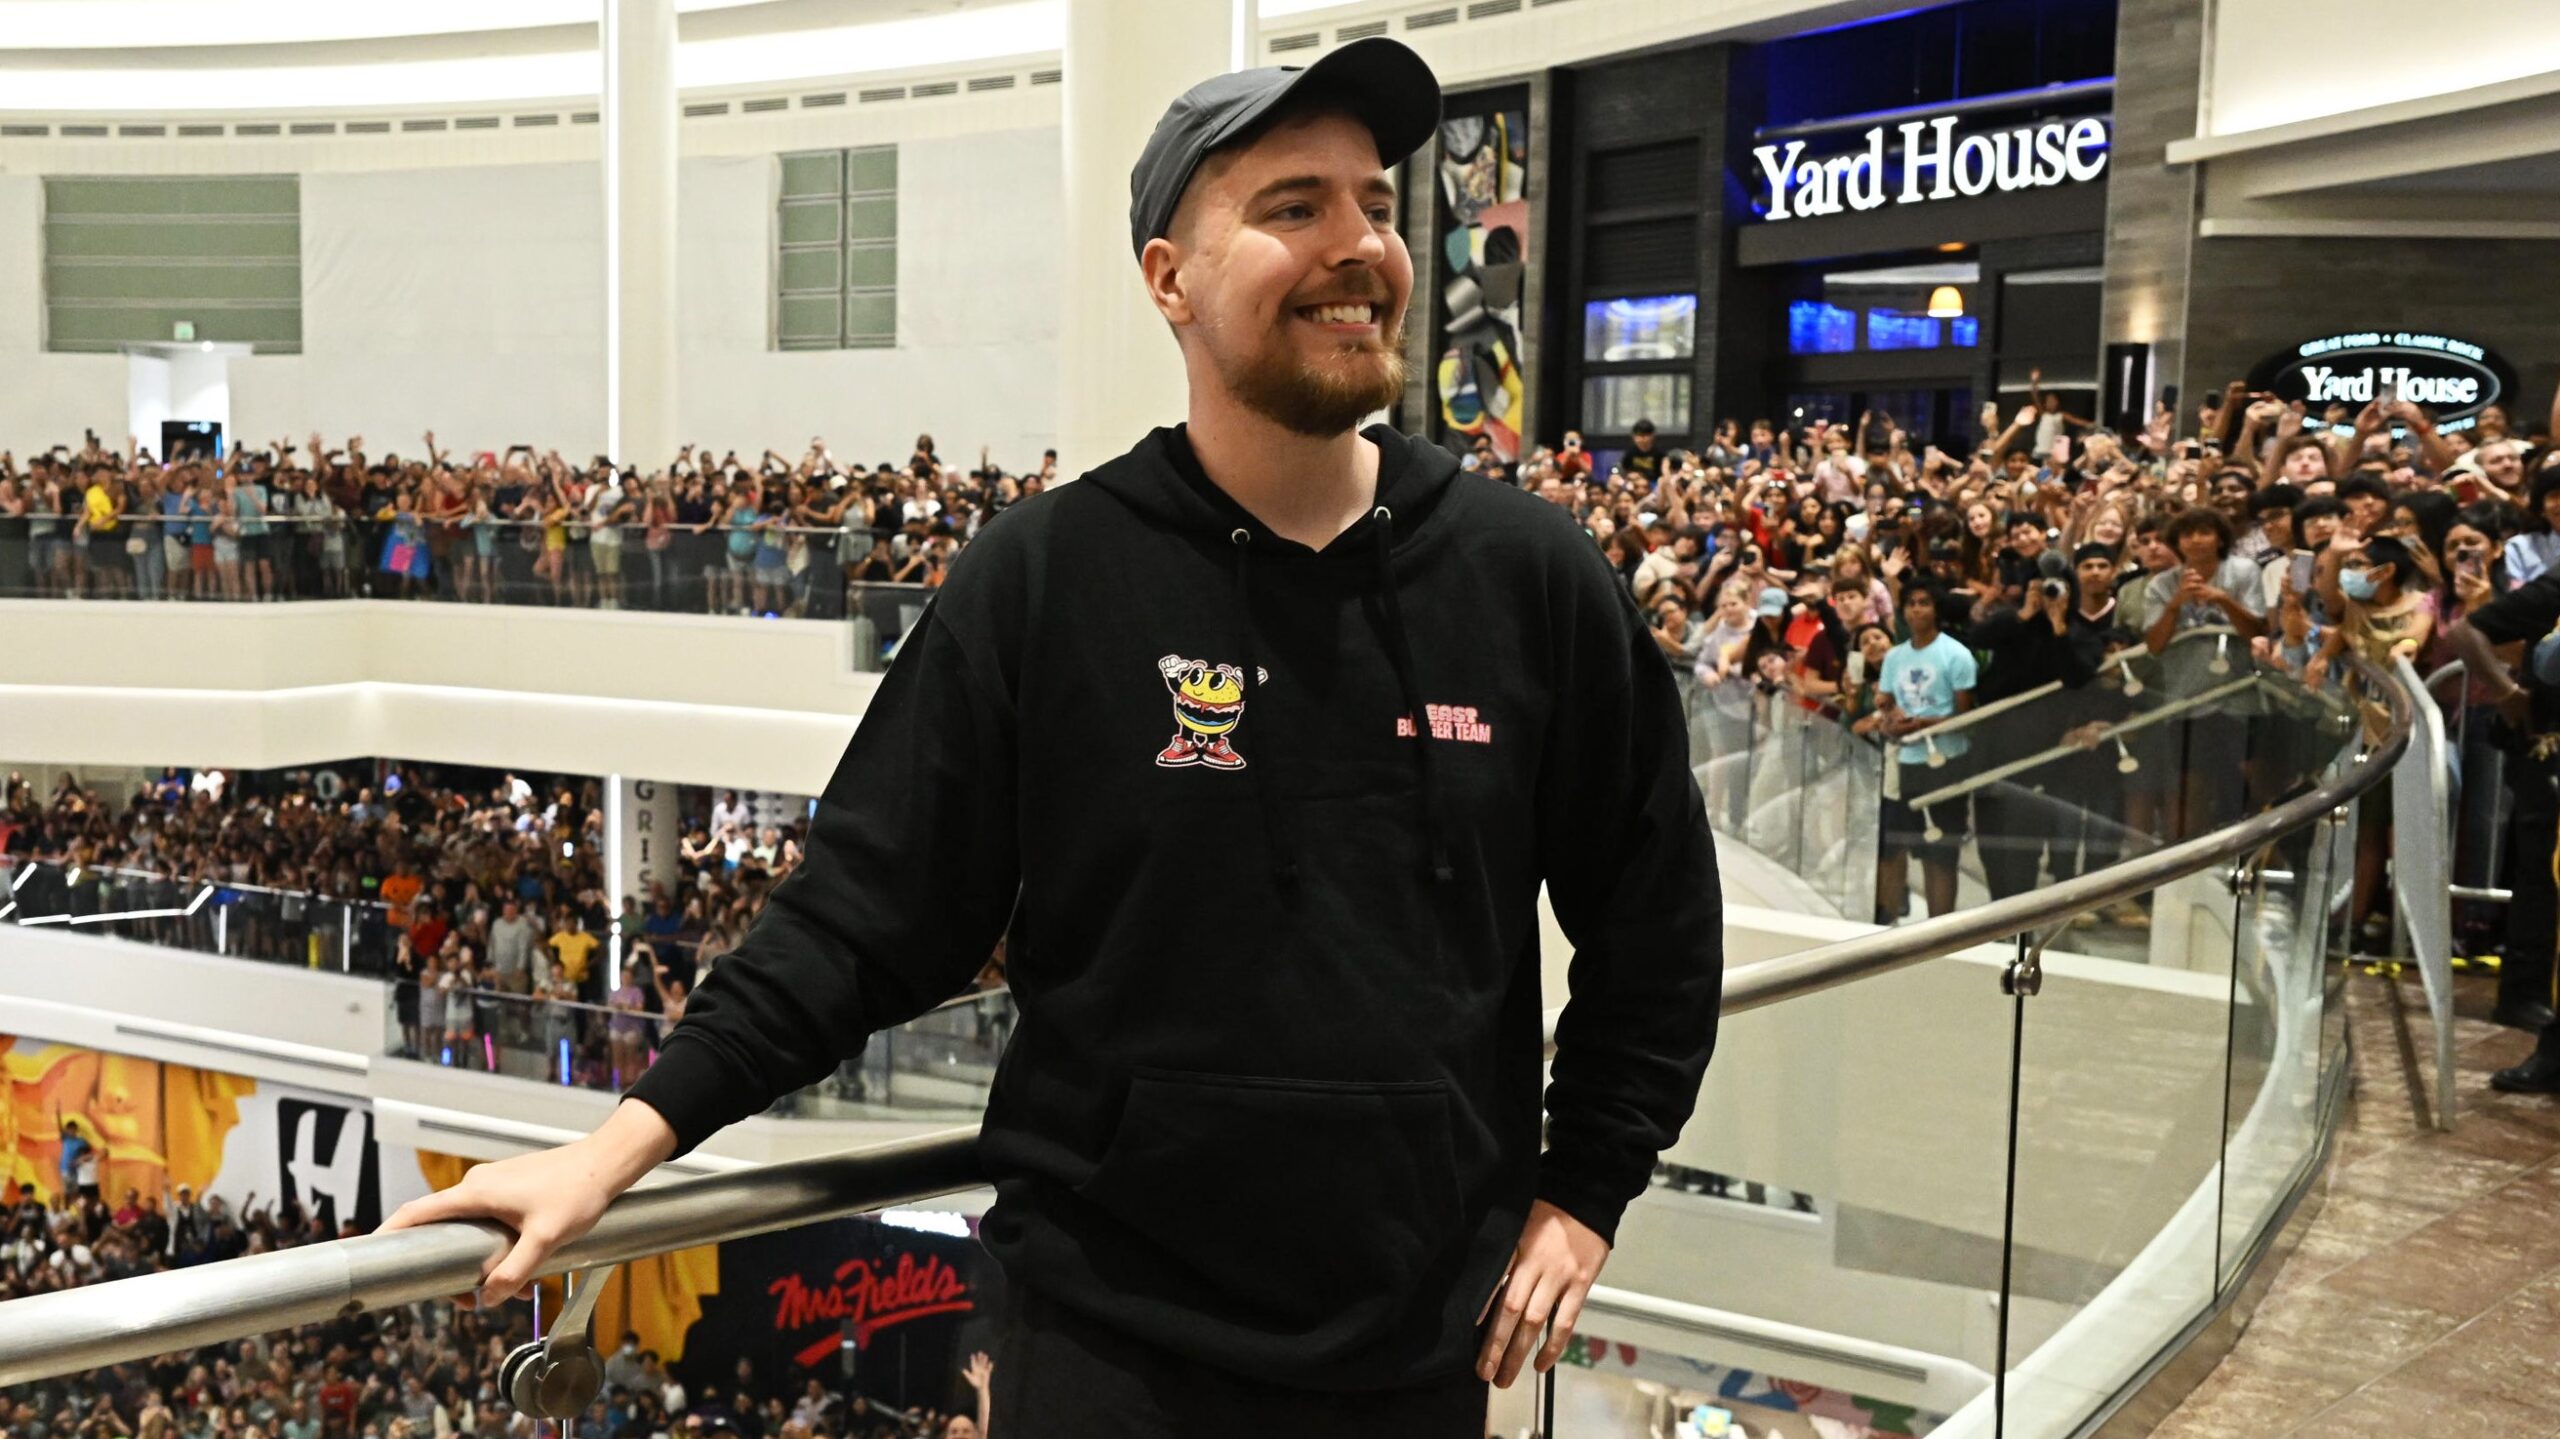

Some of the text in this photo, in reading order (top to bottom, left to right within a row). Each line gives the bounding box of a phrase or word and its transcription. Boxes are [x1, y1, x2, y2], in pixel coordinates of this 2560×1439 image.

[1752, 116, 2107, 222] Yard House
[2301, 366, 2373, 401] Yard
[1411, 703, 1479, 723] EAST
[1455, 722, 1491, 743] TEAM
[834, 1251, 966, 1324] Fields
